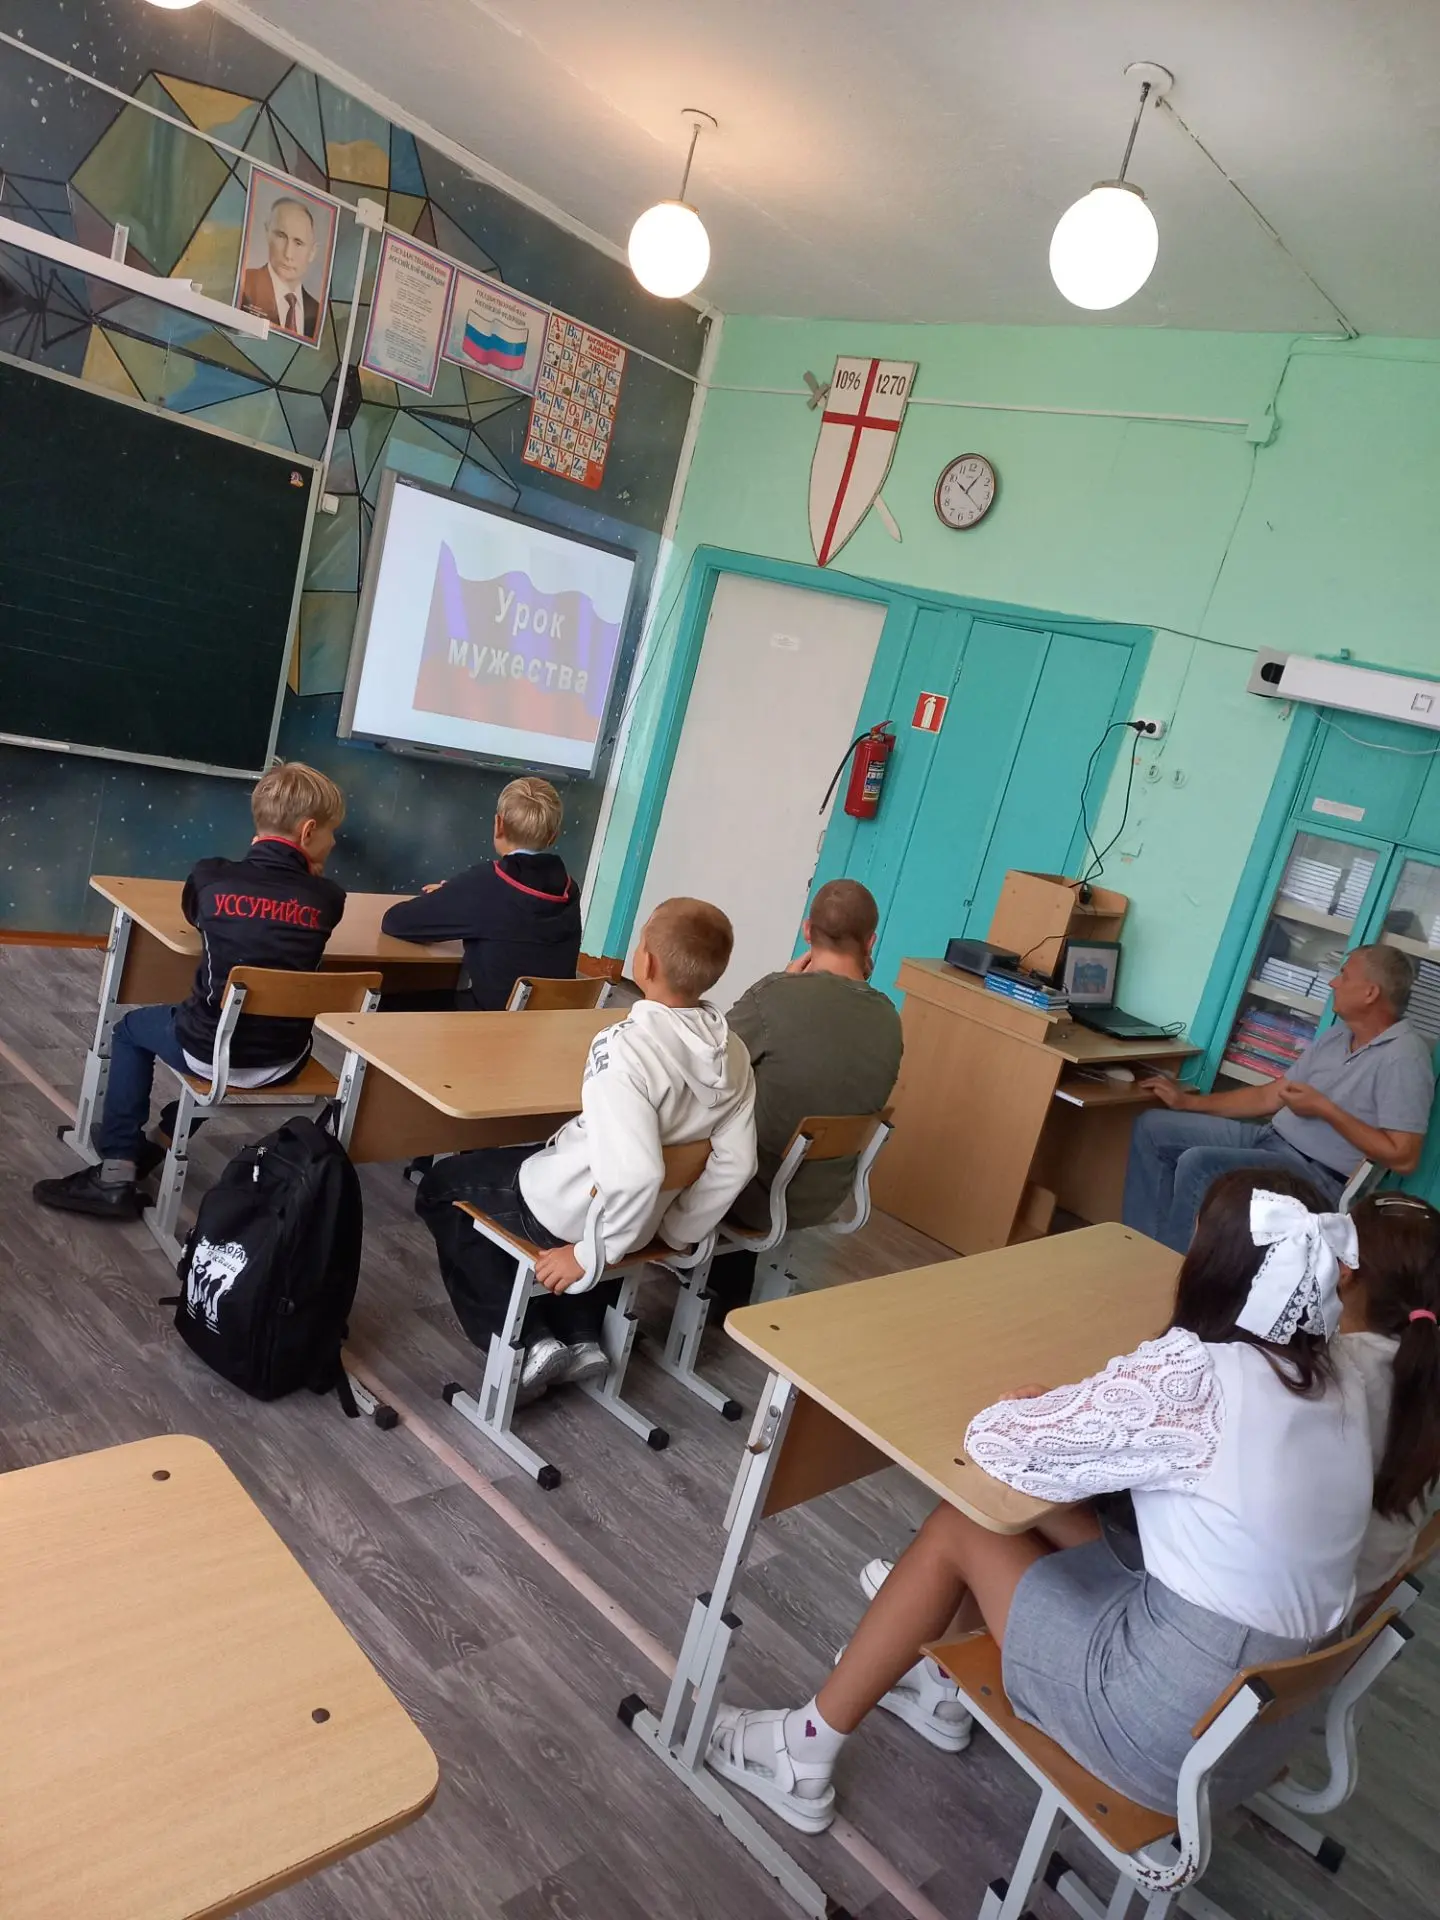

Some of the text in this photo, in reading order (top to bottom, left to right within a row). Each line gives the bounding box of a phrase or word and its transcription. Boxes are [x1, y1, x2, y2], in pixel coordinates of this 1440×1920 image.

[835, 369, 862, 391] 1096
[875, 373, 906, 396] 1270
[968, 462, 978, 472] 12
[494, 584, 566, 639] Урок
[447, 638, 589, 695] мужества
[213, 893, 322, 929] УССУРИЙСК
